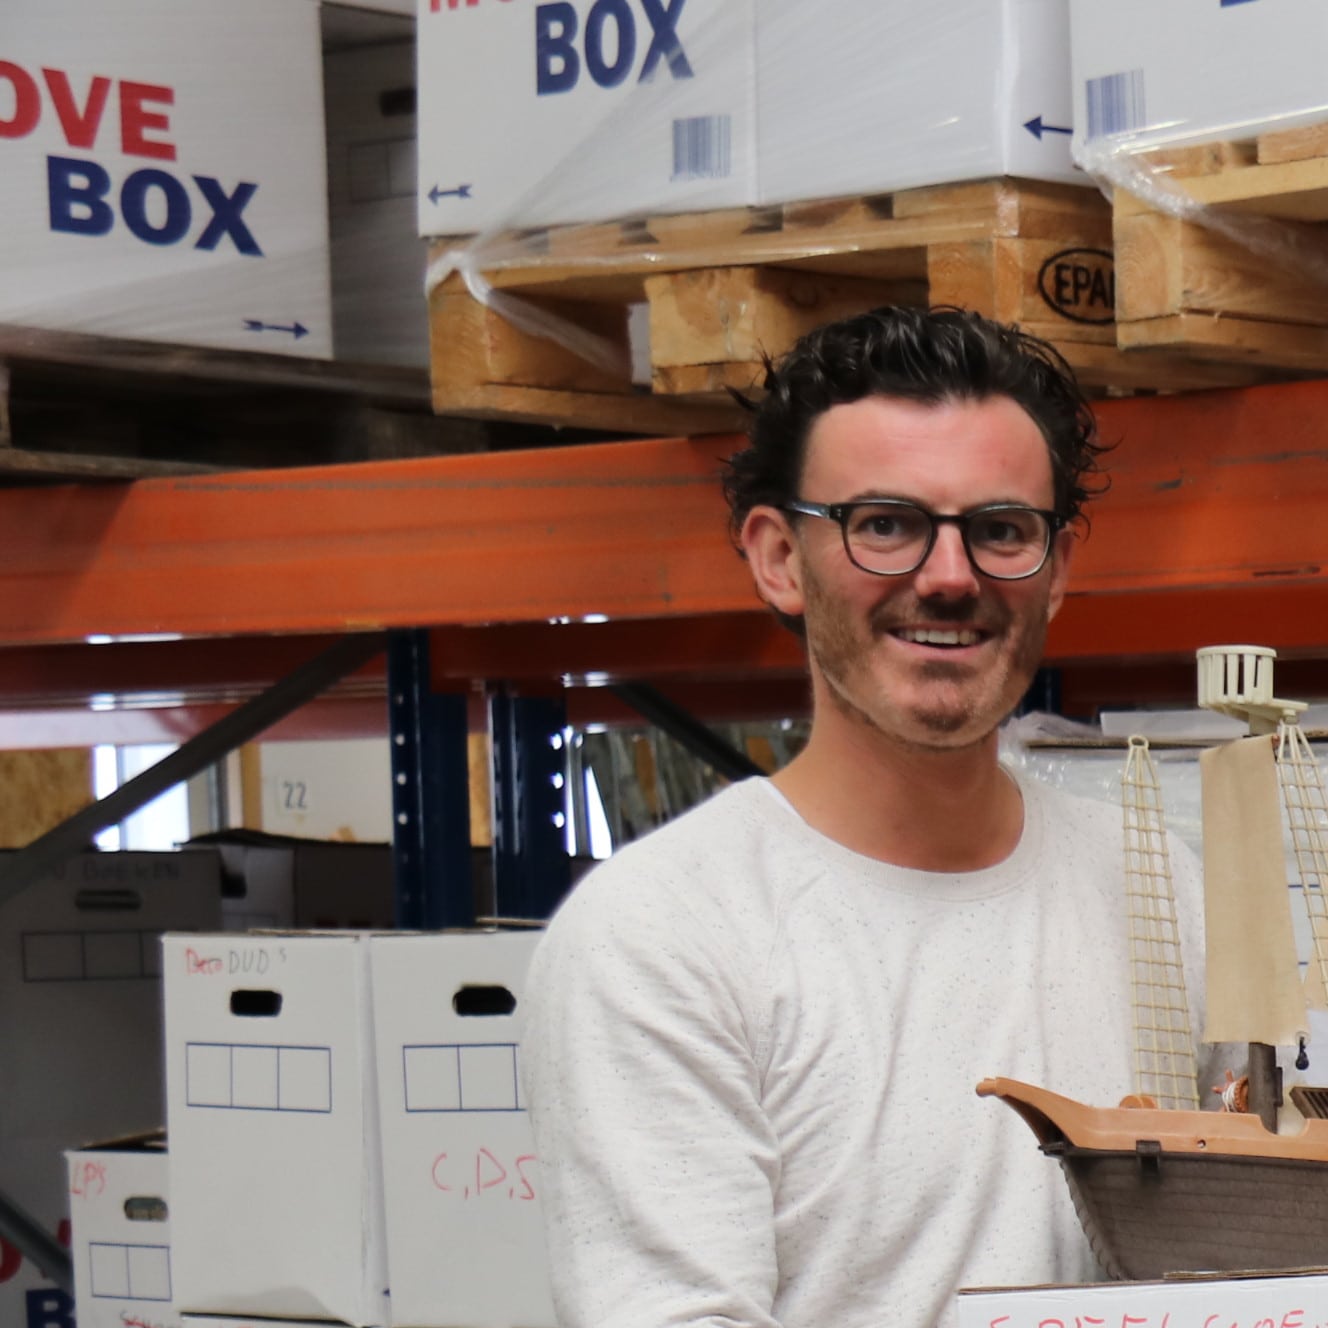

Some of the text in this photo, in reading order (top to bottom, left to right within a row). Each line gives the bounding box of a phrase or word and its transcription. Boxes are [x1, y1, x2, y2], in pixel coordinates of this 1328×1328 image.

[537, 0, 693, 95] BOX
[47, 155, 264, 256] BOX
[1054, 264, 1114, 304] EPA
